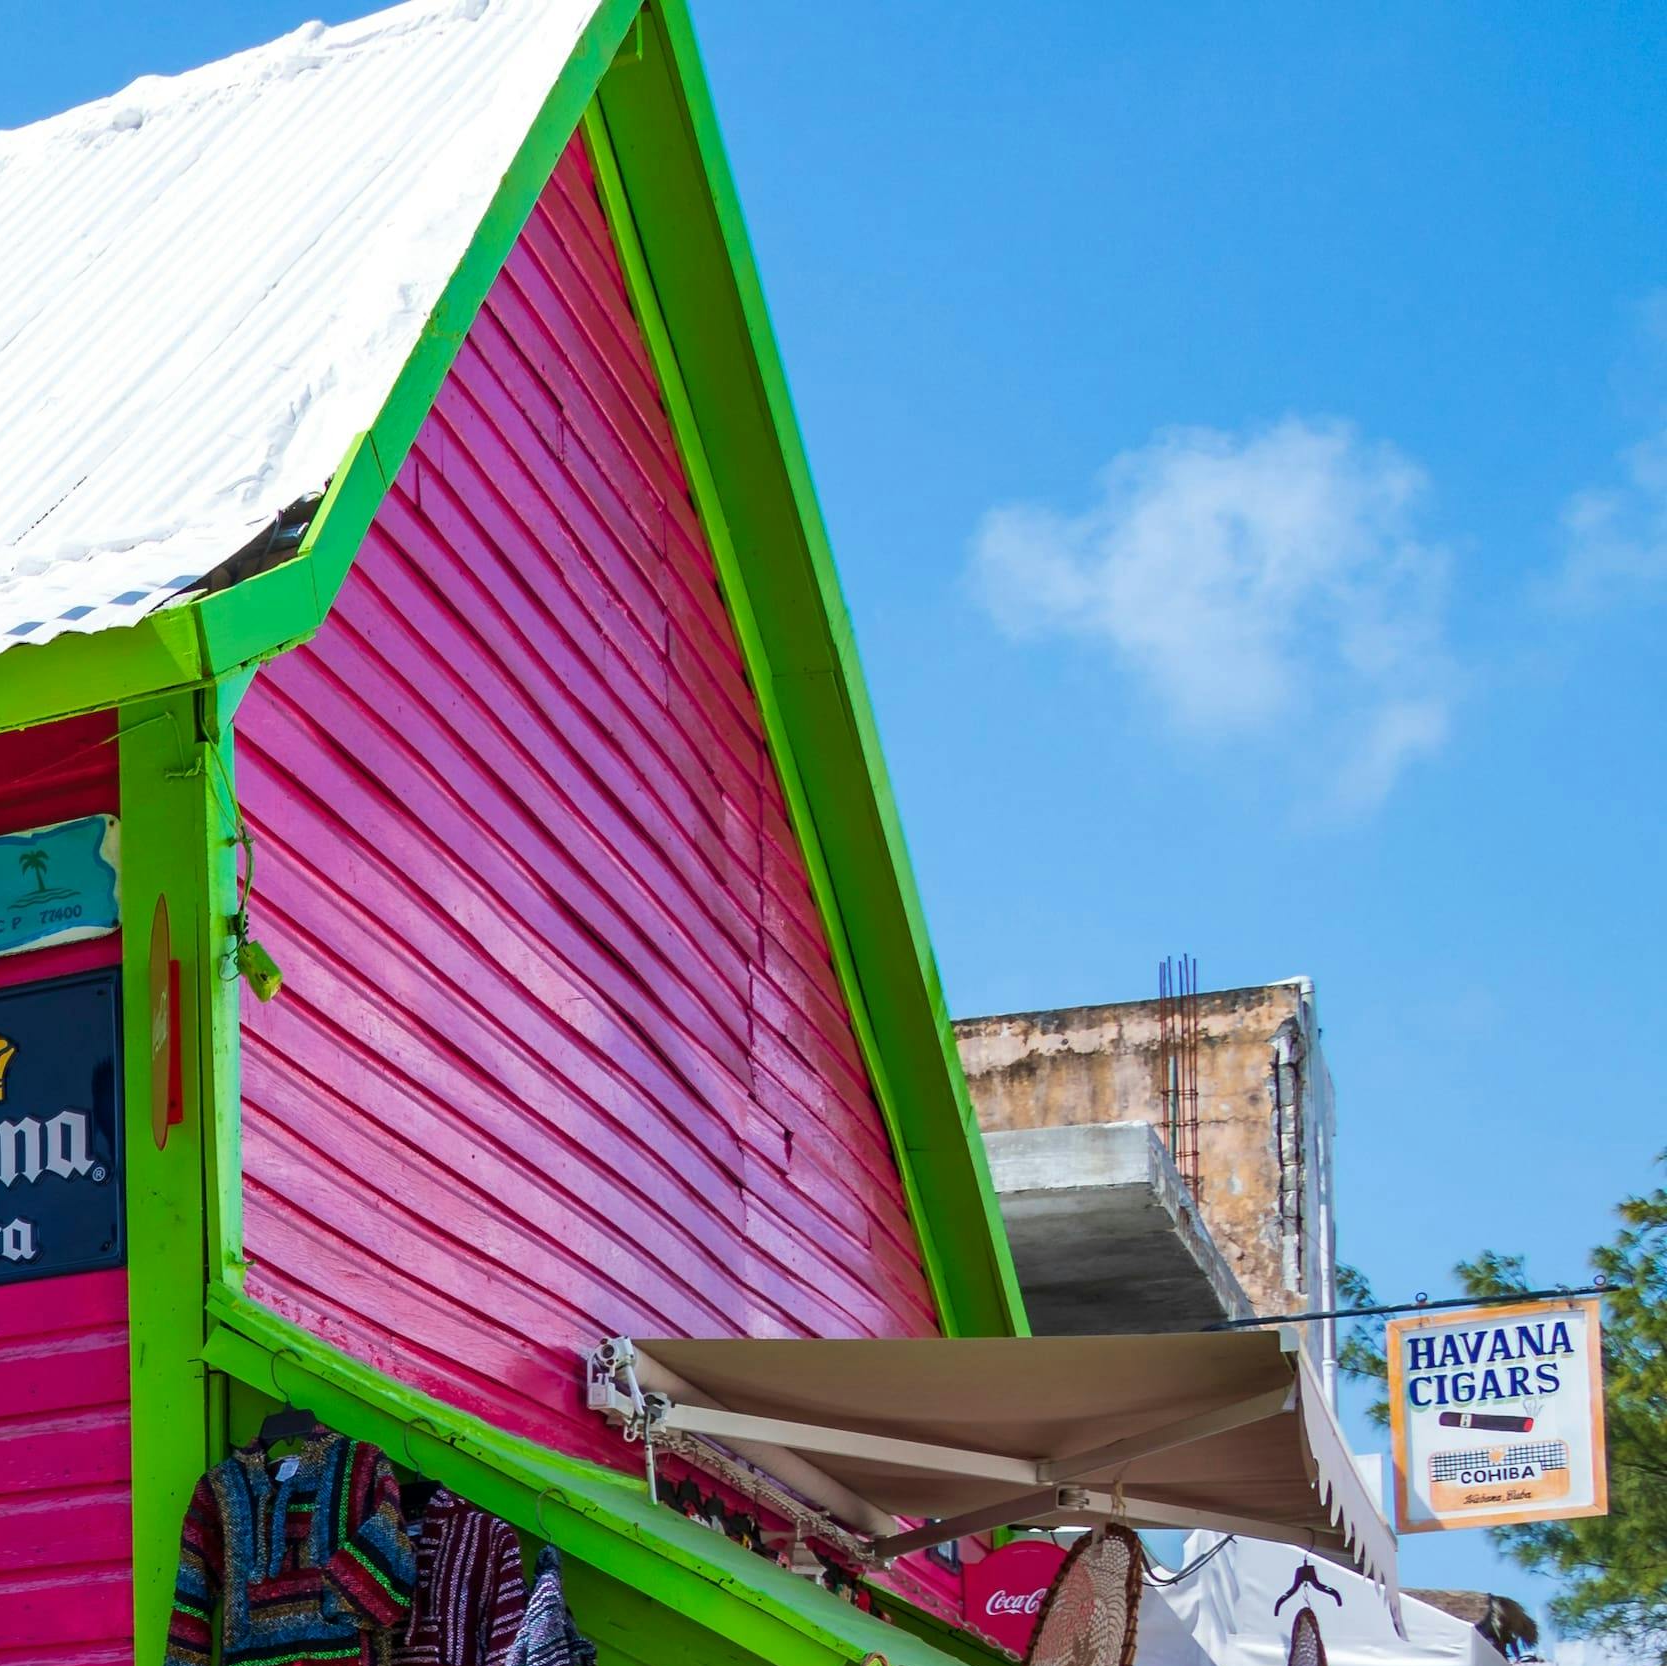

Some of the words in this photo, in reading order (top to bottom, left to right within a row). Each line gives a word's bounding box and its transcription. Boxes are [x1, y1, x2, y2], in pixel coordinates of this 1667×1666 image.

[40, 905, 82, 925] 77400
[1407, 1319, 1574, 1372] HAVANA
[1408, 1362, 1563, 1409] CIGARS
[1460, 1466, 1535, 1485] COHIBA
[986, 1588, 1048, 1615] Coca-C
